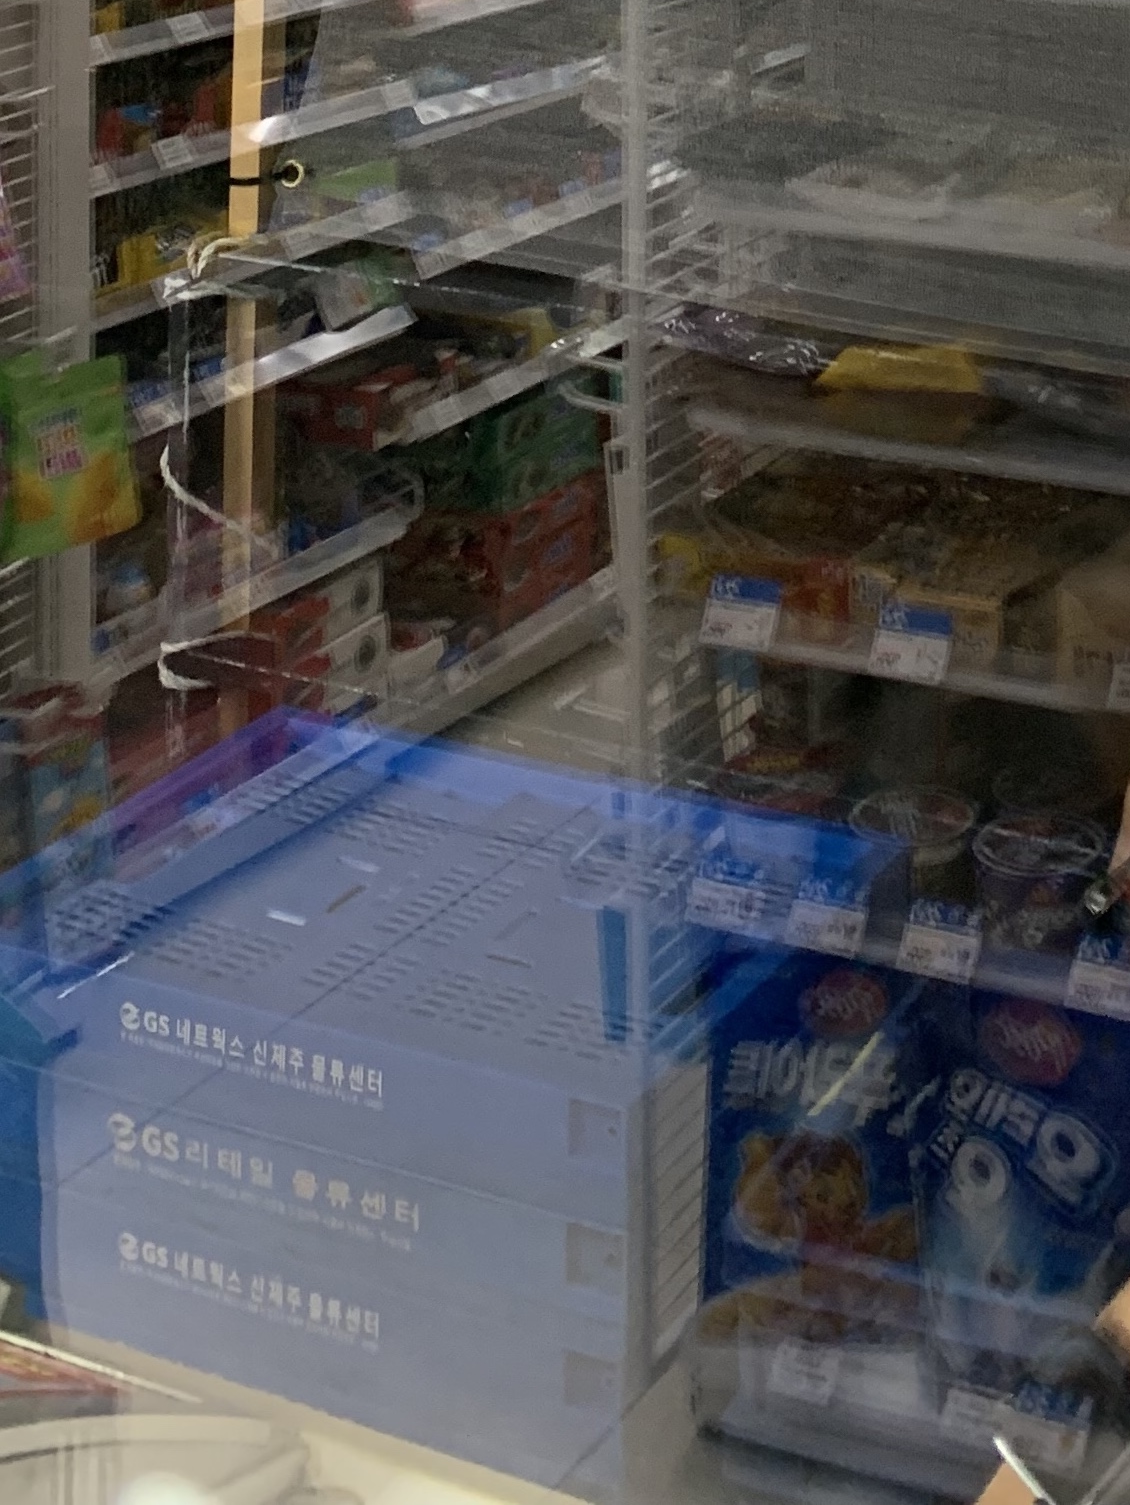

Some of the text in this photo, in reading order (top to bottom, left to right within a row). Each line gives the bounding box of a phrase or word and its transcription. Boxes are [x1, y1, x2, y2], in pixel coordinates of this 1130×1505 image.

[143, 1010, 170, 1037] GS
[176, 1018, 245, 1059] 네트웍스
[252, 1038, 305, 1076] 신제주
[311, 1054, 383, 1098] 물류센터
[141, 1239, 168, 1269] GS
